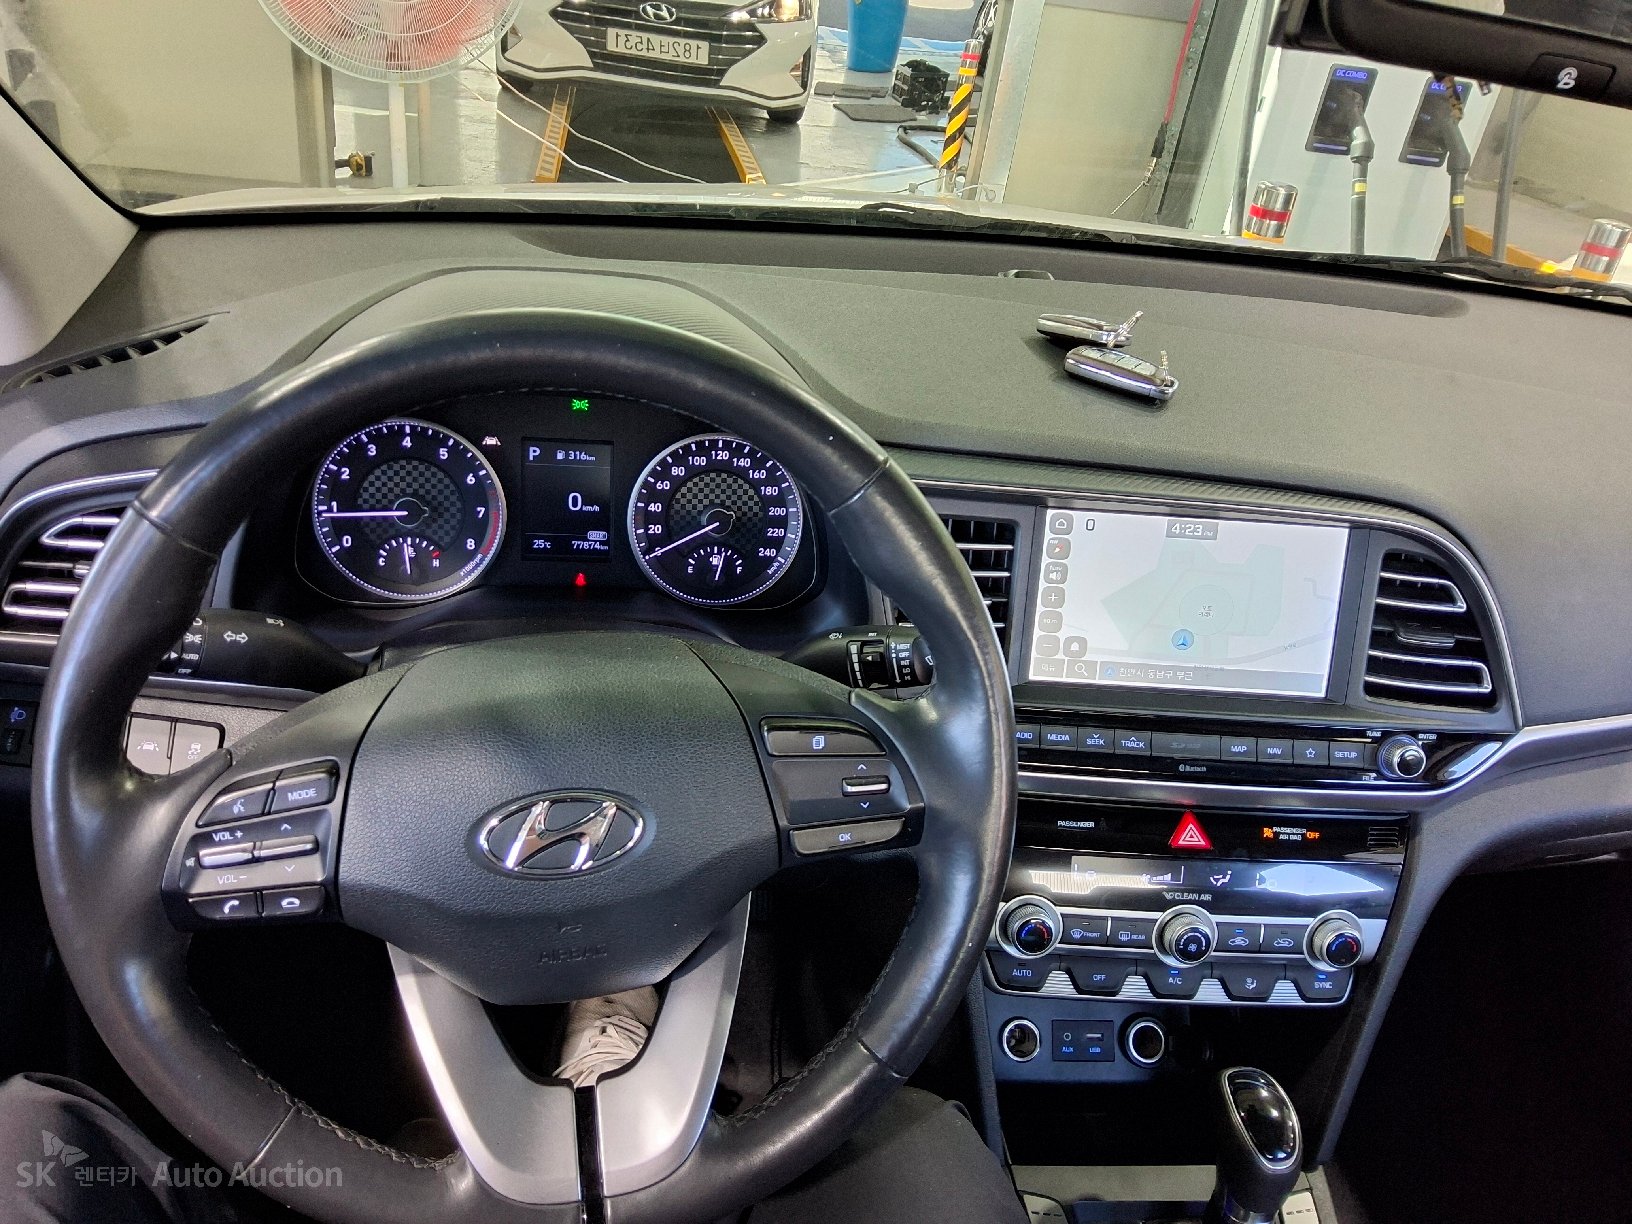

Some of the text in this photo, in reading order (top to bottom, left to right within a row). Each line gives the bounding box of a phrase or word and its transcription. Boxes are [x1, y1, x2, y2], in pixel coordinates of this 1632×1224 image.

[402, 436, 412, 448] 4
[367, 444, 377, 456] 3
[439, 448, 448, 460] 5
[529, 446, 541, 461] P
[711, 451, 729, 460] 120
[688, 457, 707, 466] 100
[733, 458, 751, 467] 140
[341, 467, 350, 479] 2
[671, 467, 685, 476] 80
[749, 470, 766, 479] 160
[466, 472, 476, 484] 6
[656, 481, 670, 490] 60
[760, 486, 778, 495] 180
[568, 492, 582, 511] 0
[331, 501, 338, 513] 1
[647, 503, 662, 512] 40
[769, 507, 786, 516] 200
[476, 507, 486, 519] 7
[648, 525, 662, 534] 20
[767, 528, 785, 537] 220
[1171, 523, 1203, 536] 4:23
[342, 535, 352, 547] 0
[466, 538, 476, 550] 8
[758, 548, 776, 557] 240
[378, 558, 386, 566] C
[433, 559, 440, 567] H
[688, 566, 693, 574] E
[737, 566, 743, 574] F
[1016, 731, 1033, 739] ADIO
[1047, 733, 1070, 741] MEDIA
[1086, 738, 1106, 746] SEEK
[1121, 740, 1145, 749] TRACK
[1231, 745, 1247, 753] MAP
[1267, 747, 1283, 755] NAV
[1334, 751, 1358, 759] SETUP
[287, 788, 318, 801] MODE
[1057, 820, 1095, 828] PASSENGER
[1272, 826, 1307, 834] PASSENGER
[838, 832, 852, 842] OK
[1174, 892, 1212, 901] CLEAN AIR
[1012, 968, 1032, 977] AUTO
[1168, 976, 1182, 986] A/C
[1314, 980, 1333, 990] SYNC
